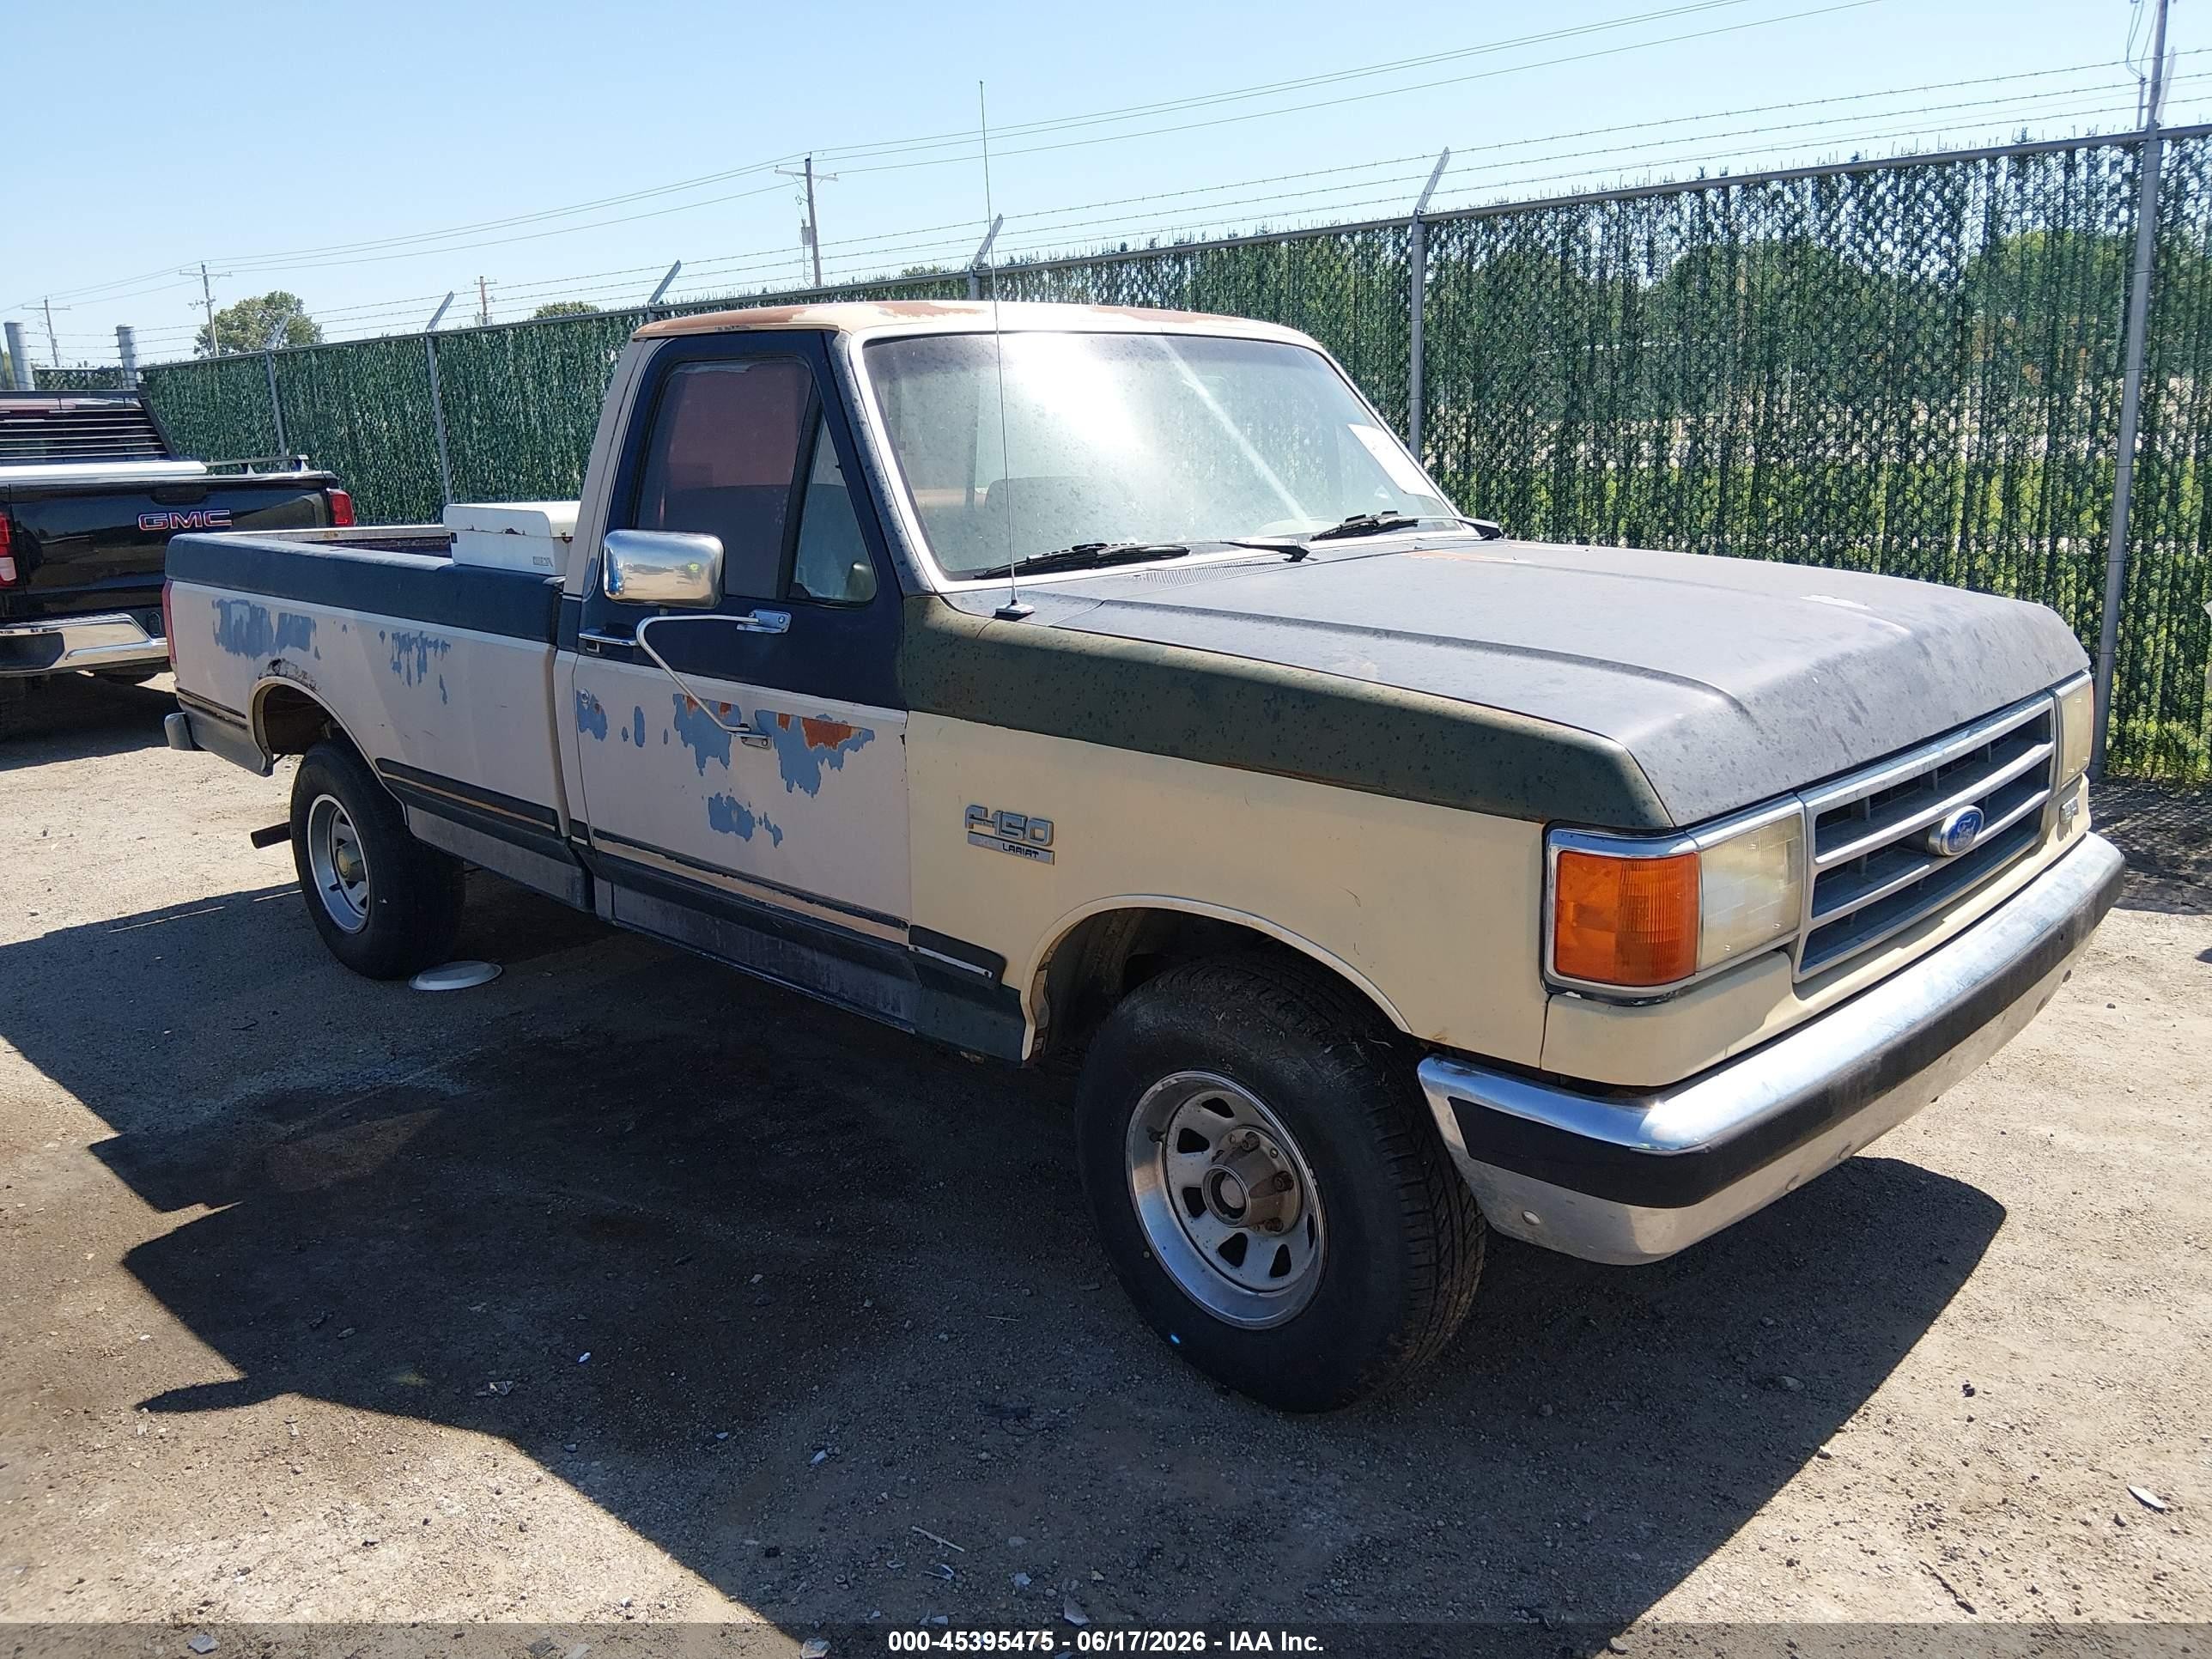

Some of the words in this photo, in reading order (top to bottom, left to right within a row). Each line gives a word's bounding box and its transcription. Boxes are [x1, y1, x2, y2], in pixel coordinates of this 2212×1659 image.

[138, 509, 233, 531] GMC
[964, 805, 1054, 847] F-150
[1002, 842, 1040, 859] LARIAT
